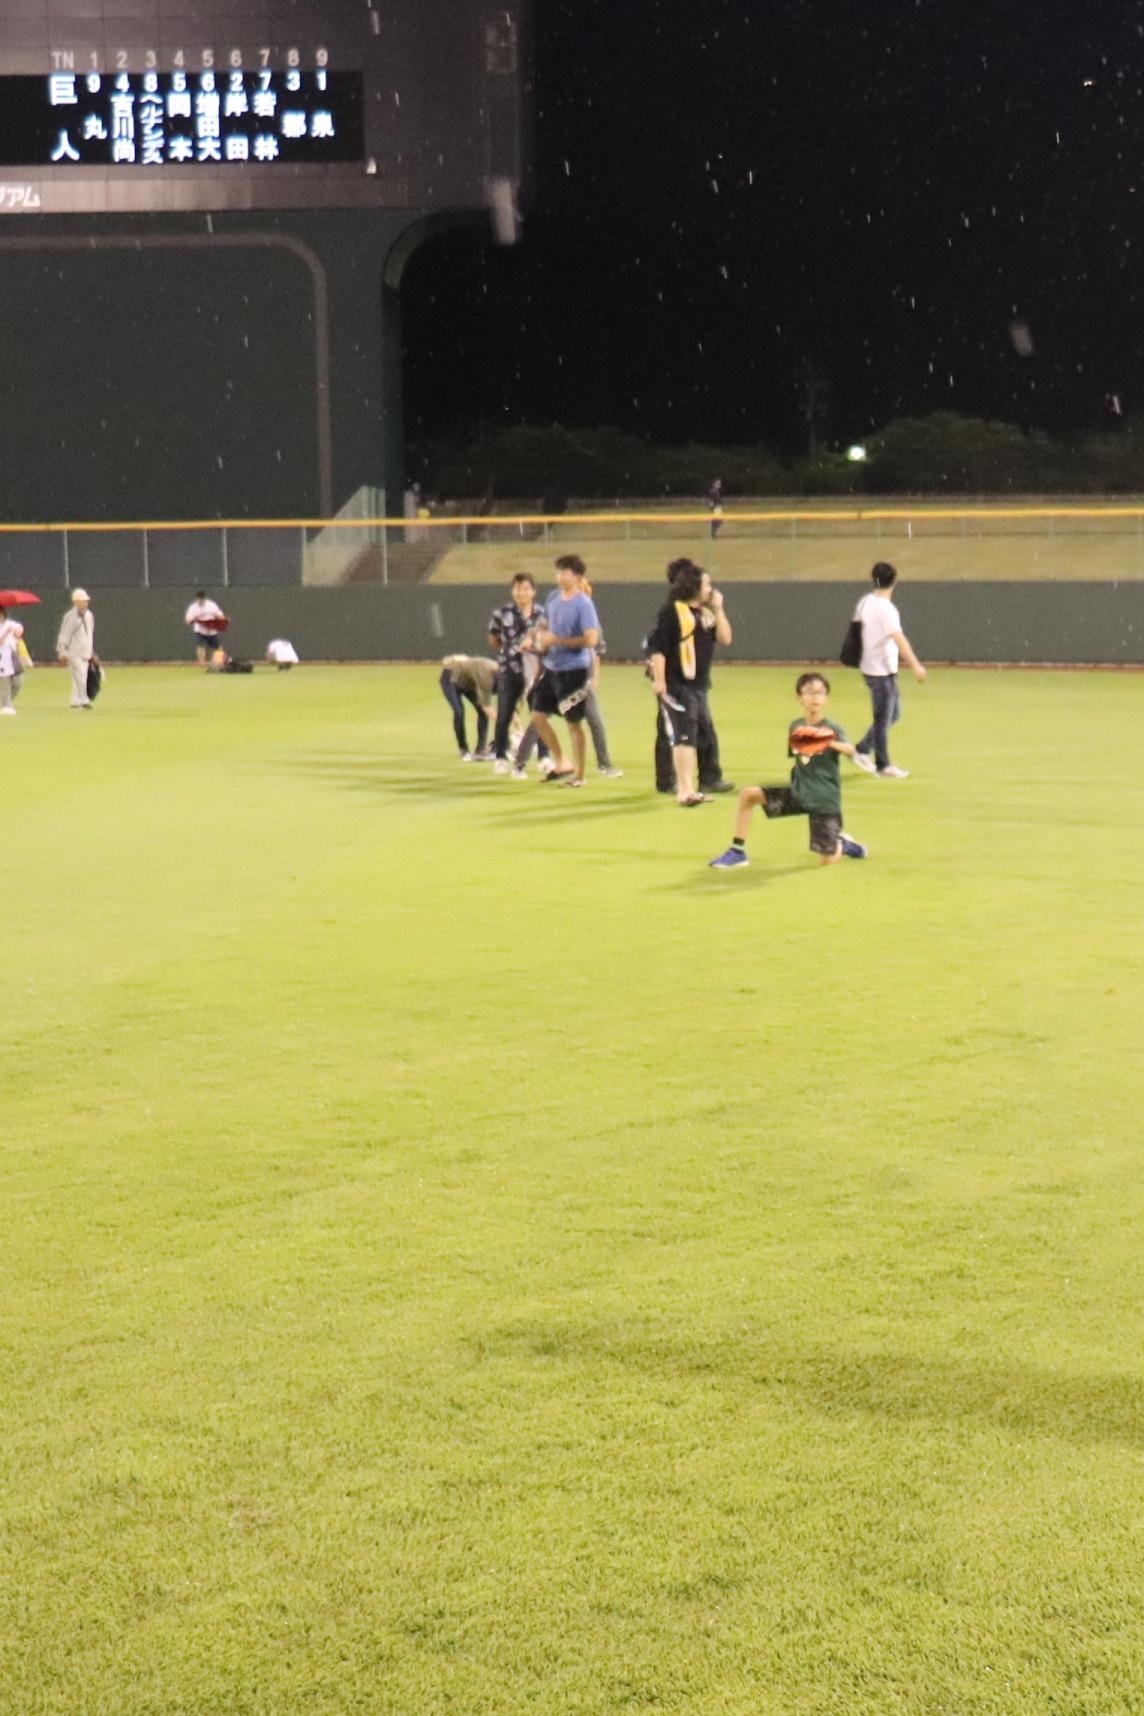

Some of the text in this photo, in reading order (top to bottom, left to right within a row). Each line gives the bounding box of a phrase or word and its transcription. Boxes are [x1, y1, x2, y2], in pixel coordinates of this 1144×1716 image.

[90, 51, 98, 69] 1
[117, 50, 129, 69] 2
[145, 50, 157, 68] 3
[174, 50, 185, 68] 4
[202, 49, 215, 68] 5
[230, 49, 243, 67] 6
[259, 48, 271, 67] 7
[287, 48, 300, 67] 8
[315, 48, 329, 67] 9
[86, 70, 327, 93] 9 4 8 5 6 2 7 3 1
[49, 74, 80, 161] 巨人
[84, 115, 108, 140] 丸
[253, 89, 279, 161] 若林
